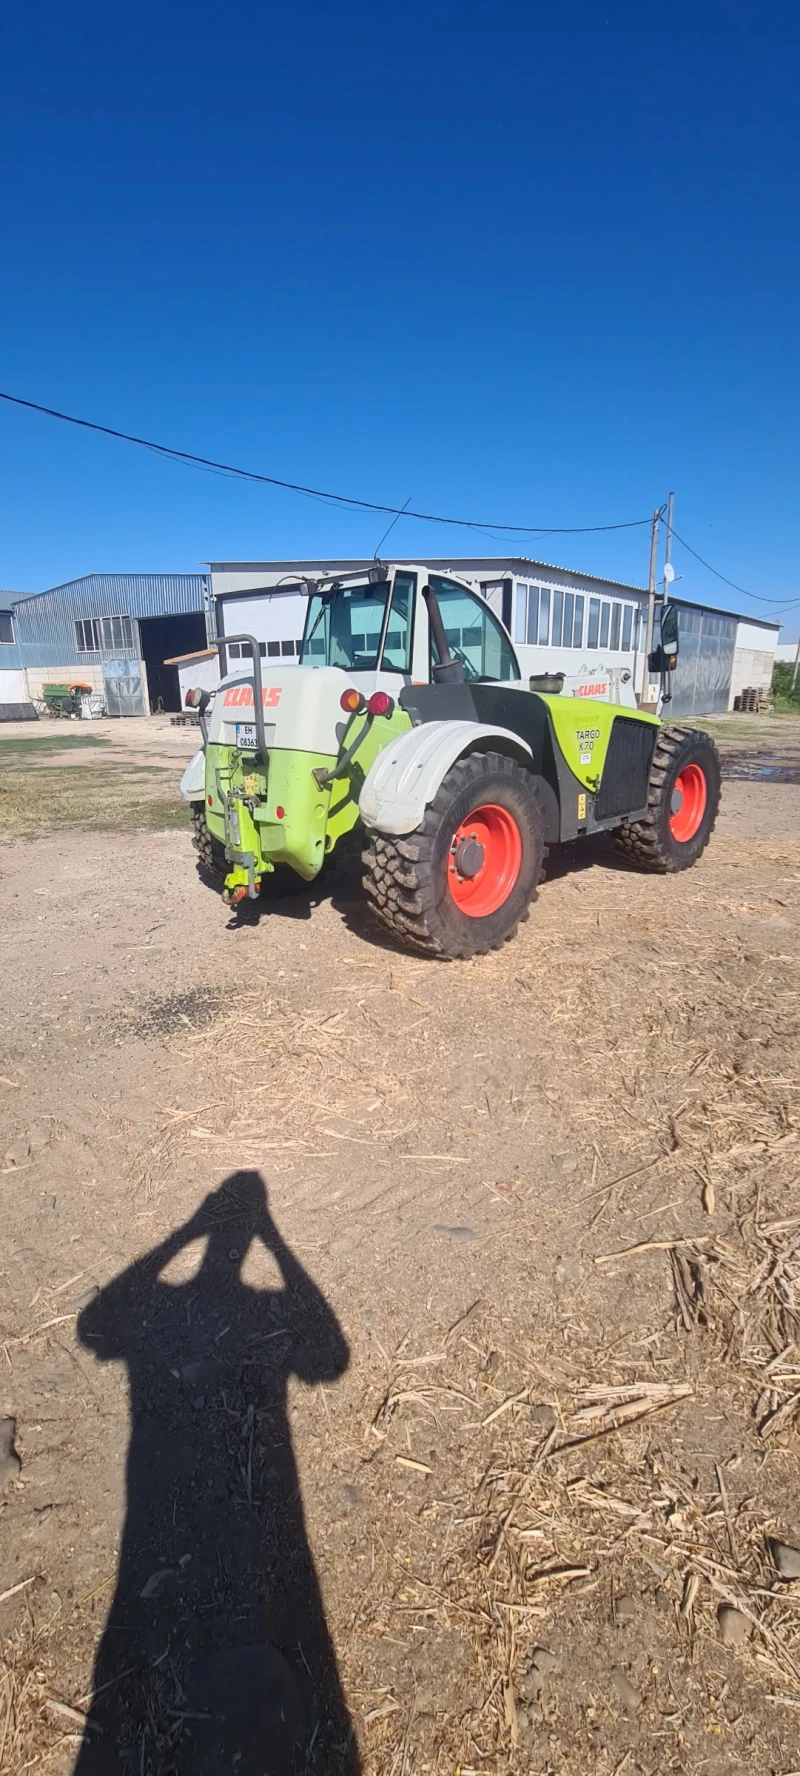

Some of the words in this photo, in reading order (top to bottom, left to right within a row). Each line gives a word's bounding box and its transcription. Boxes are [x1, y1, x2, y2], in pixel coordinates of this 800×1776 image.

[579, 684, 607, 696] CLAAS
[245, 726, 252, 734] EH
[576, 729, 600, 740] TARGO
[240, 738, 258, 747] 08363
